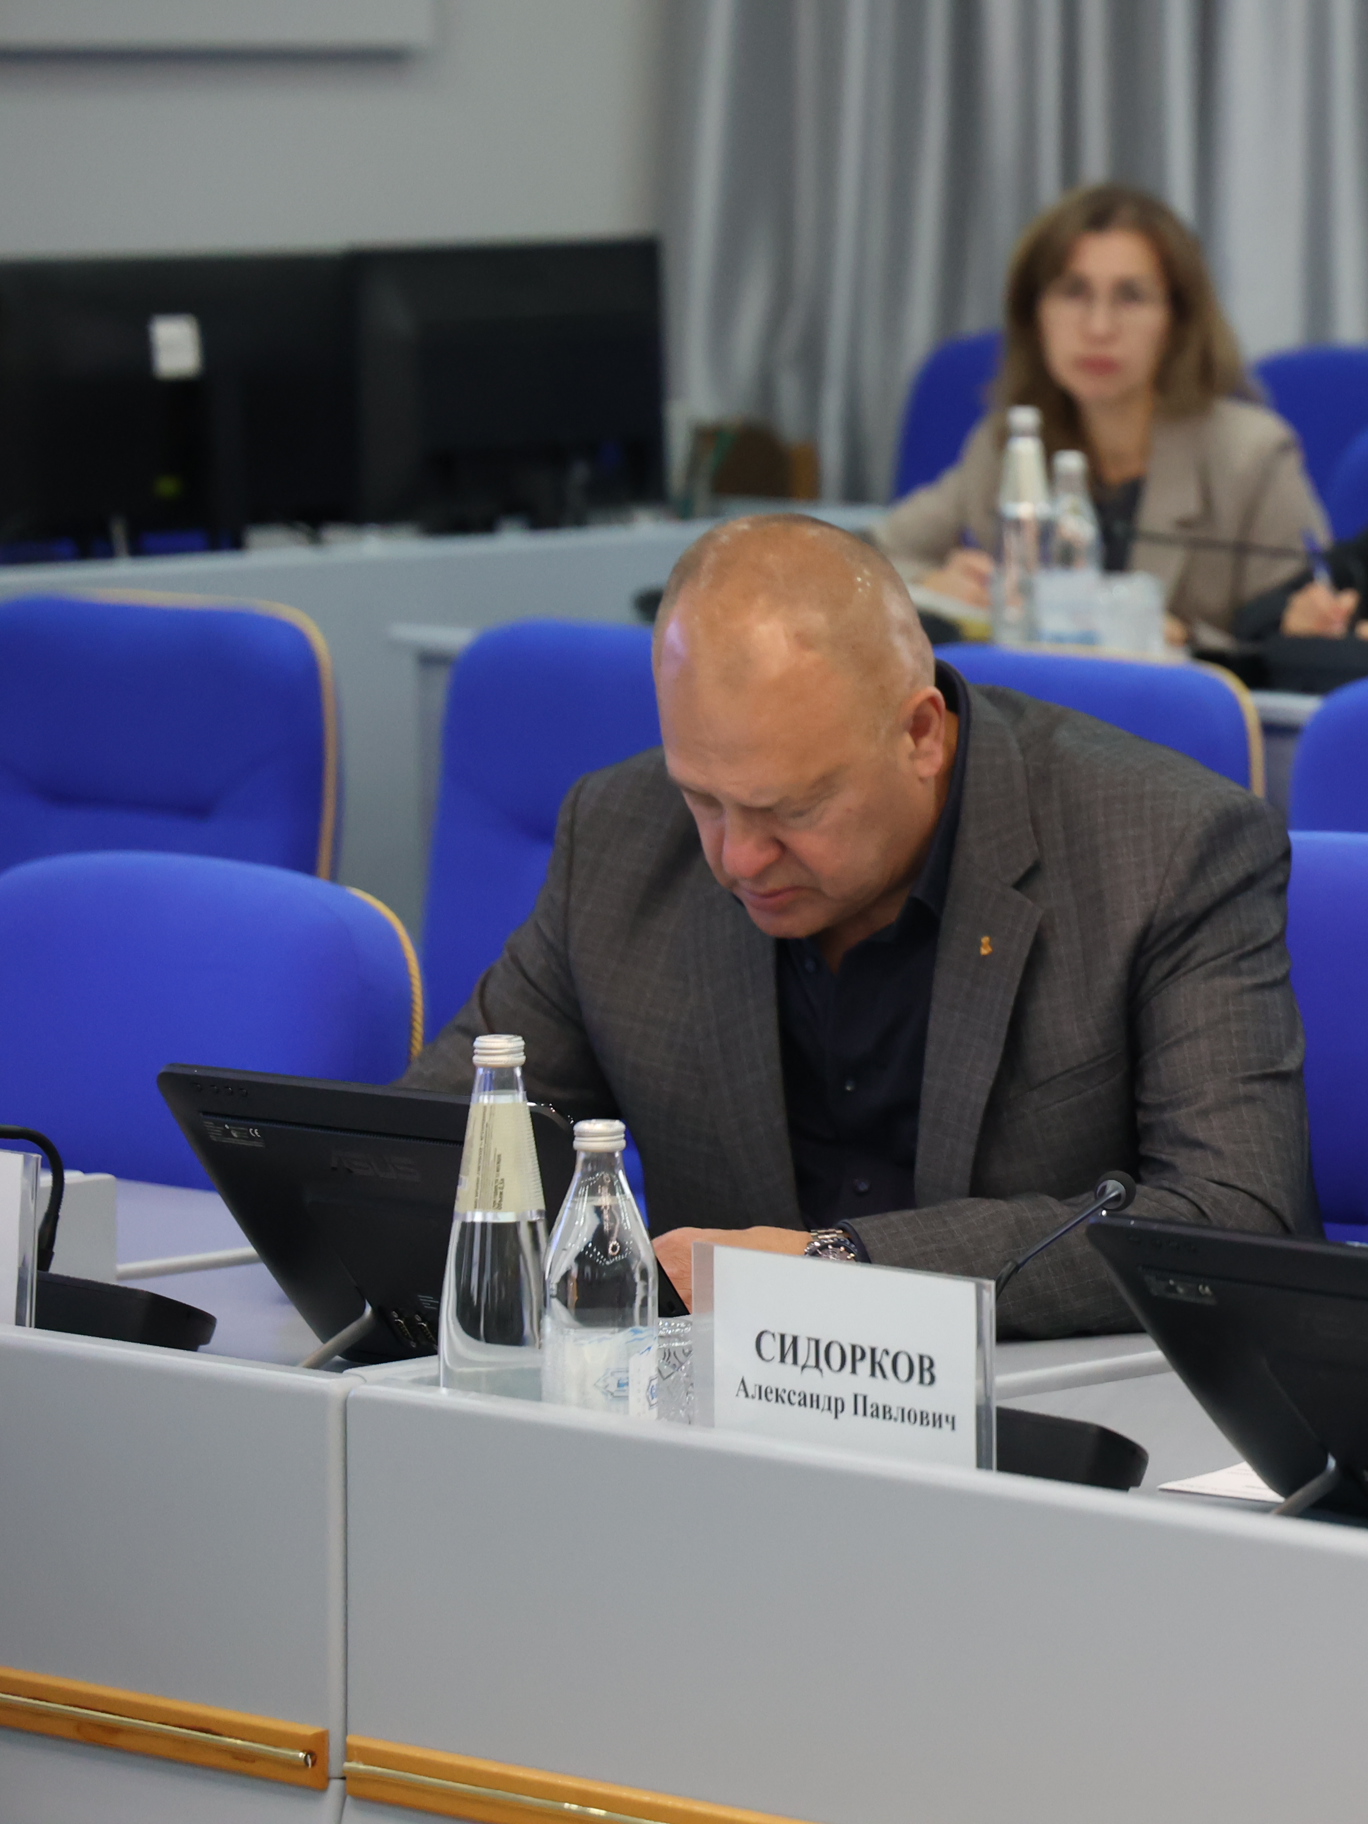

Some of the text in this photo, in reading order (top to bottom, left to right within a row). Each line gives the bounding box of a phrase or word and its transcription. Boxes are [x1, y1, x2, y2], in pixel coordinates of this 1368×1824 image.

[755, 1329, 937, 1387] СИДОРКОВ
[735, 1376, 956, 1431] Александр Павлович
